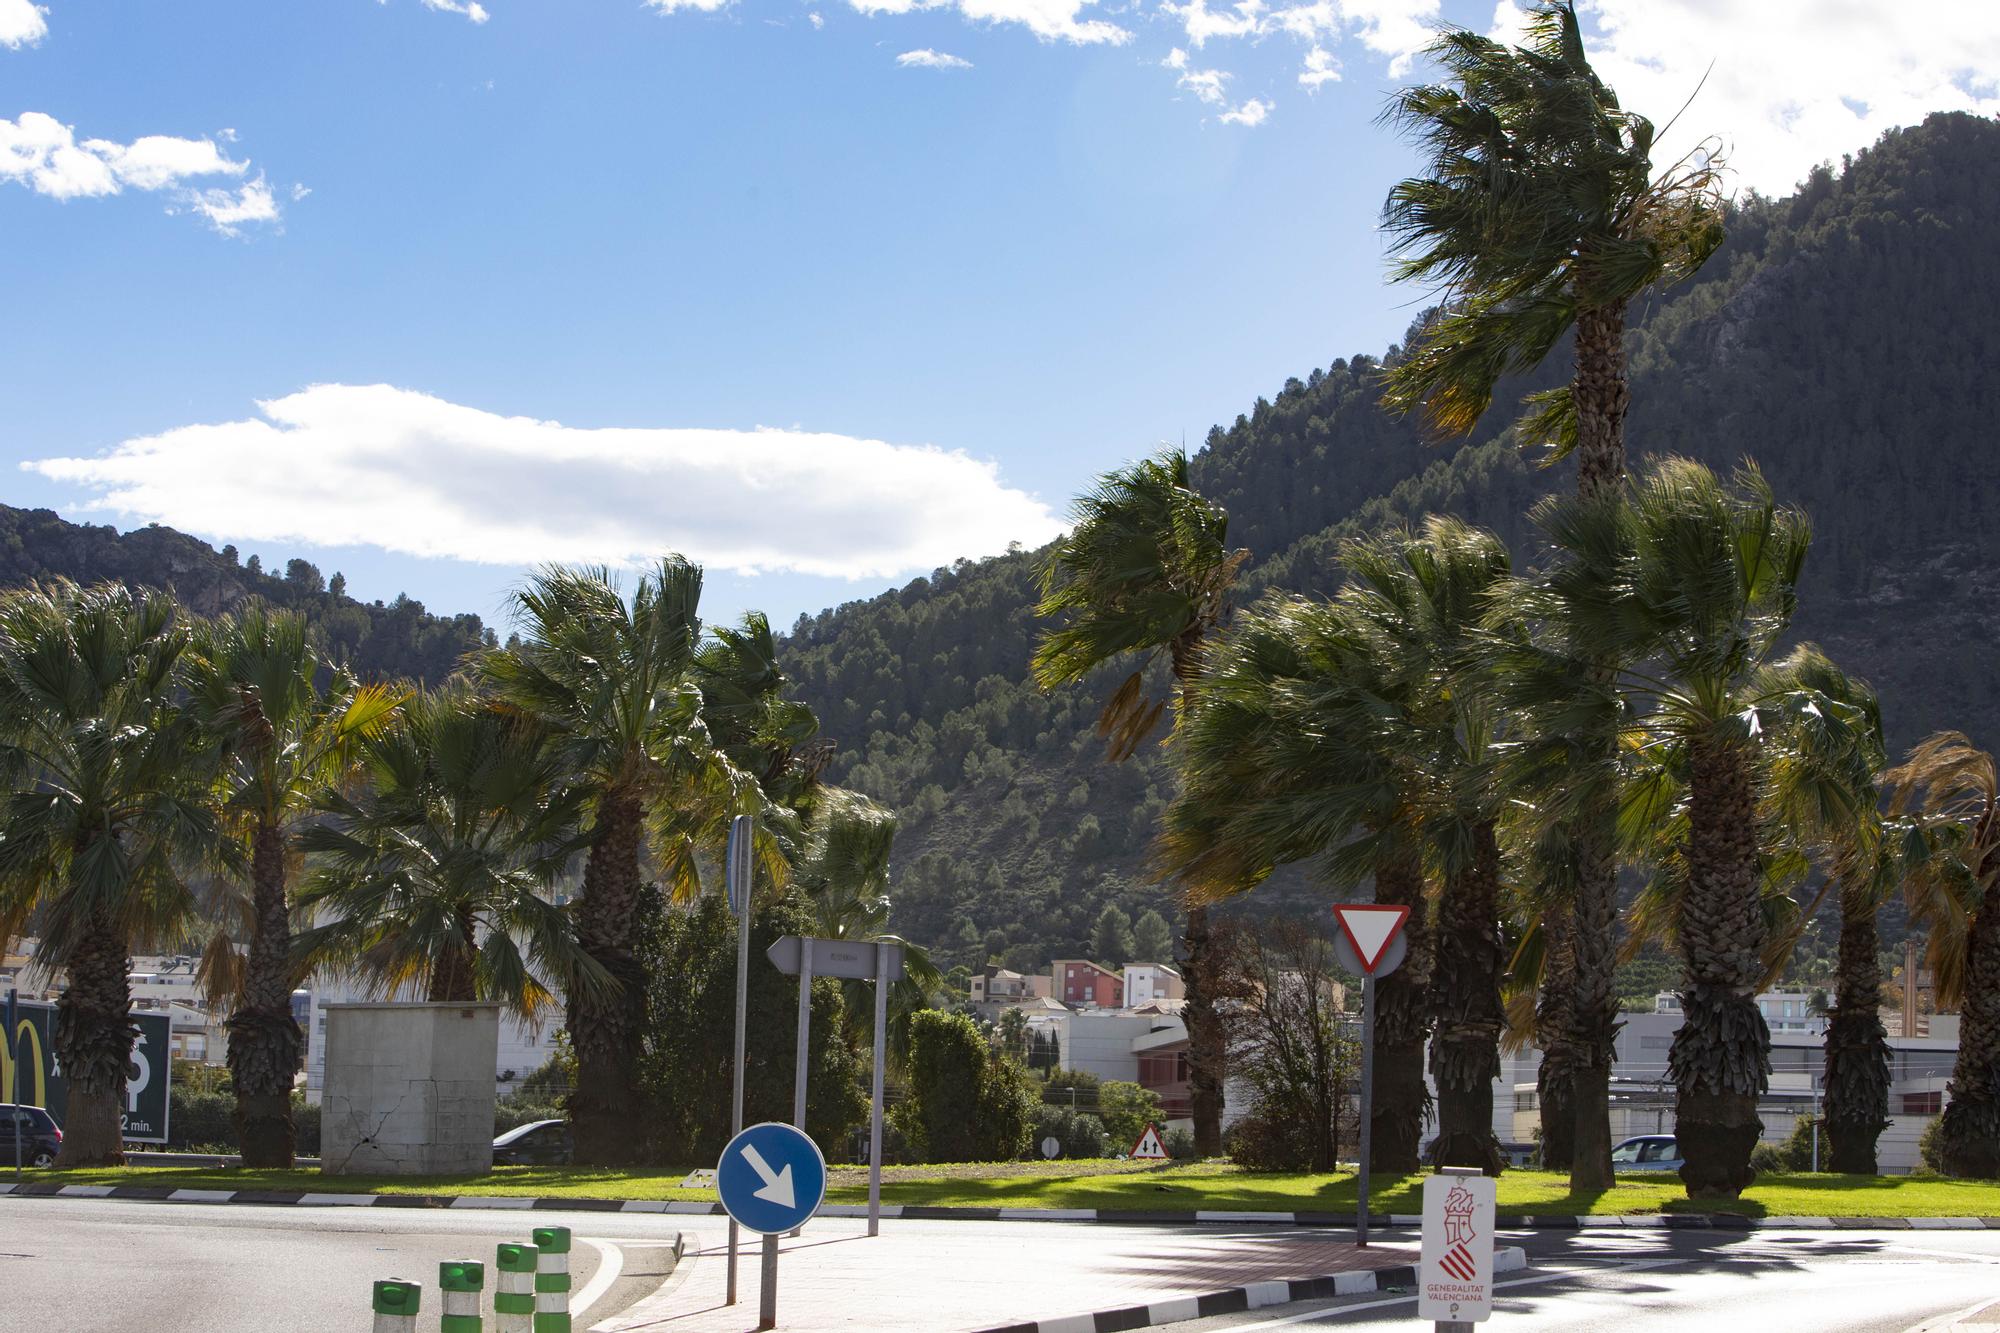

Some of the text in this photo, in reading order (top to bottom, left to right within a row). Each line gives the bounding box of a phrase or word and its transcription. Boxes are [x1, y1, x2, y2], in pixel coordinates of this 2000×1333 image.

[120, 1114, 152, 1132] 2 min.
[1427, 1284, 1484, 1293] GENERALITAT
[1428, 1293, 1483, 1302] VALENCIANA
